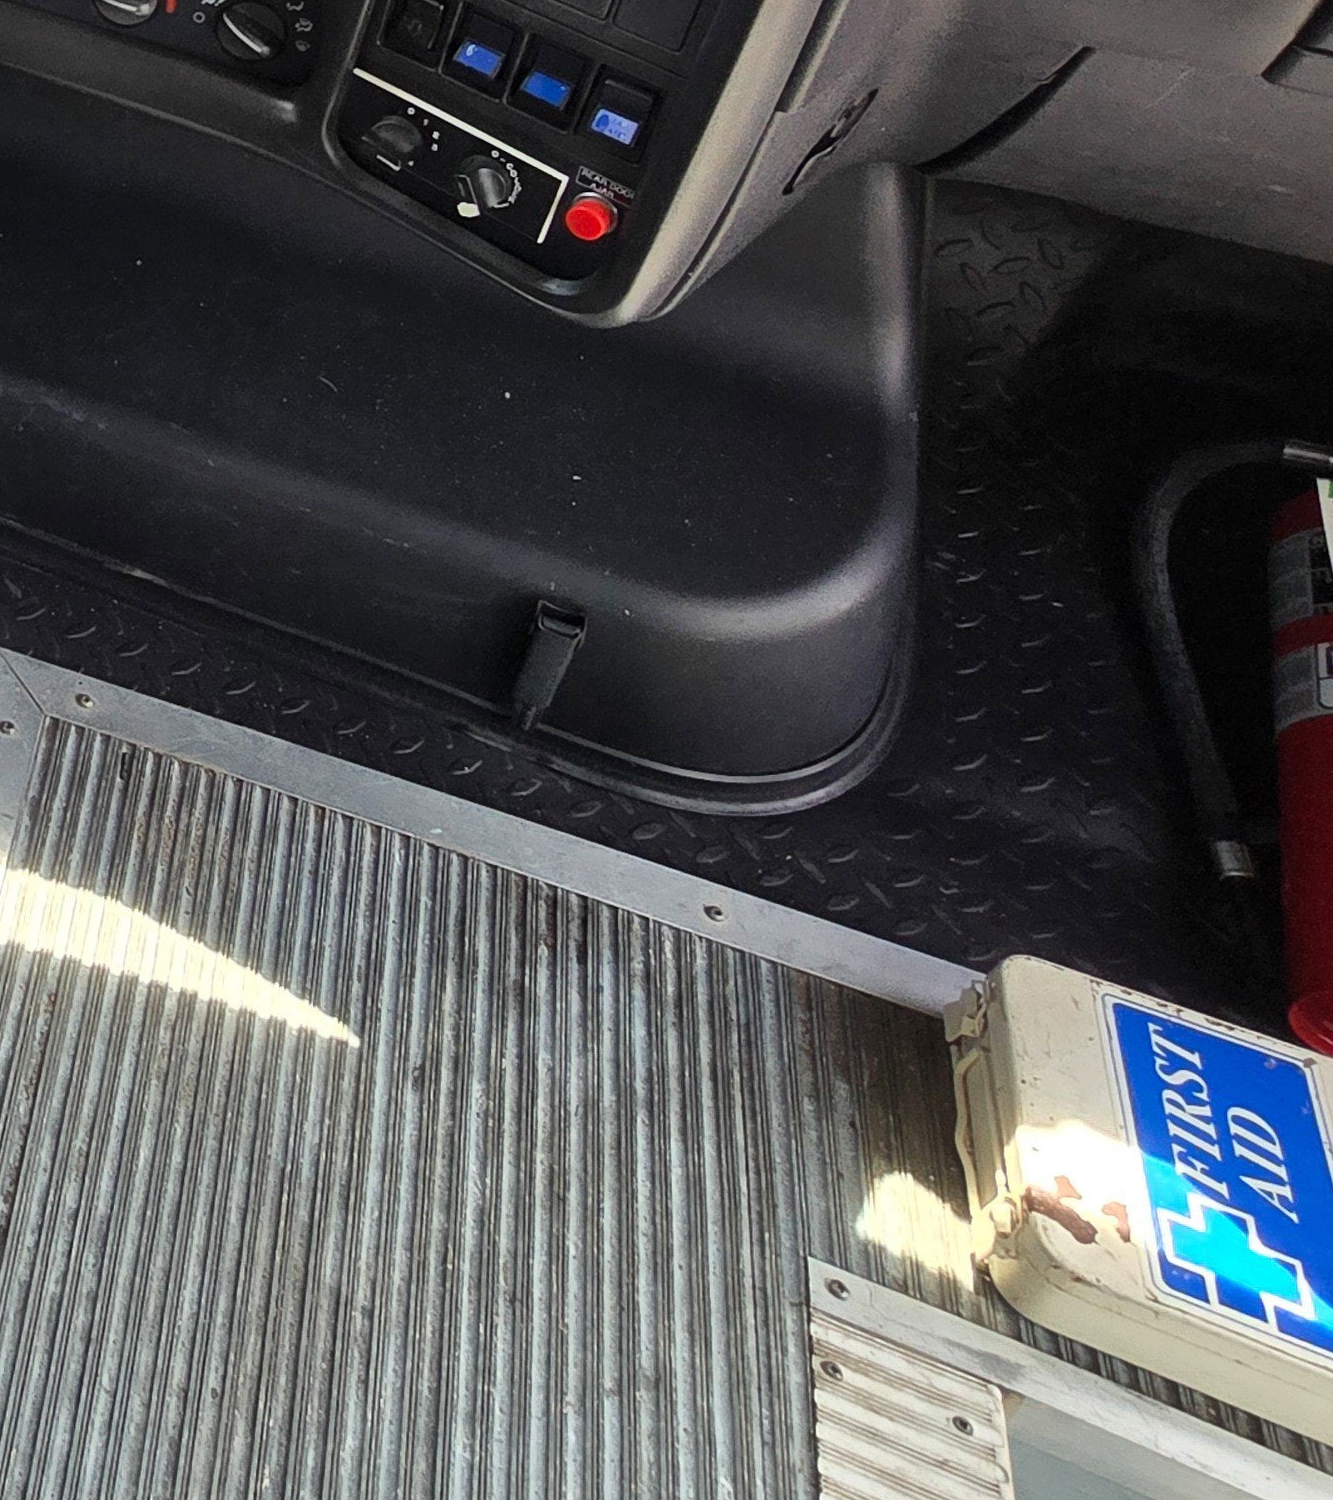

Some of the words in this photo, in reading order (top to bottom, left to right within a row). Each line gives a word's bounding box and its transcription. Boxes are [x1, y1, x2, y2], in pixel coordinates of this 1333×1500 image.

[581, 168, 609, 187] REAR
[590, 182, 614, 198] AJAR
[1147, 1022, 1230, 1200] FIRST
[1226, 1106, 1299, 1224] AID
